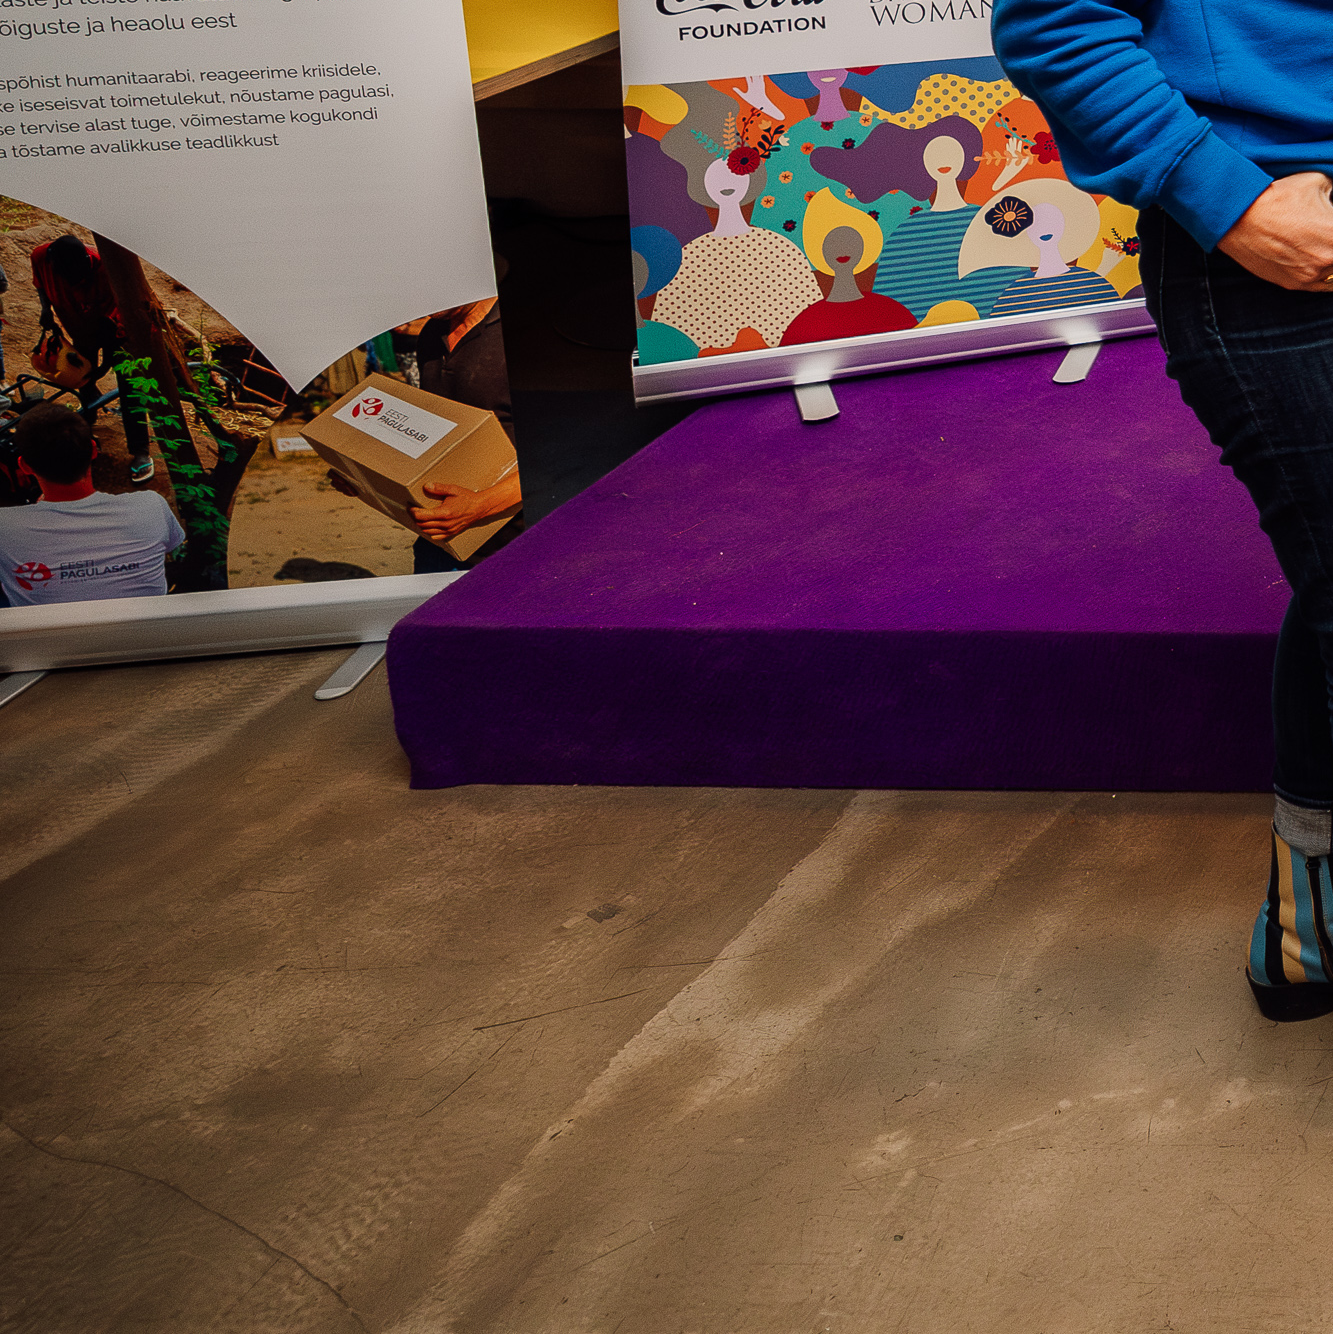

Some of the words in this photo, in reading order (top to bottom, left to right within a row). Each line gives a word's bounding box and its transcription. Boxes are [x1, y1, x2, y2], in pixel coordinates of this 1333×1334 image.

[85, 18, 105, 37] ja
[111, 14, 185, 33] heaolu
[191, 12, 238, 30] eest
[678, 16, 826, 41] FOUNDATION
[66, 68, 195, 88] humanitaarabi,
[200, 66, 298, 84] reageerime
[302, 62, 381, 79] kriisidele,
[19, 96, 106, 113] iseseisvat
[110, 90, 226, 110] toimetulekut,
[230, 89, 315, 104] nõustame
[319, 84, 394, 103] pagulasi,
[20, 120, 81, 135] tervise
[85, 117, 127, 133] alast
[131, 115, 176, 133] tuge,
[180, 112, 286, 128] võimestame
[290, 107, 378, 126] kogukondi
[12, 143, 86, 159] tõstame
[90, 138, 182, 155] avalikkuse
[186, 133, 279, 150] teadlikkust
[385, 408, 410, 423] EESTI
[378, 415, 429, 443] PAGULASABI
[60, 562, 140, 580] PAGULASABI
